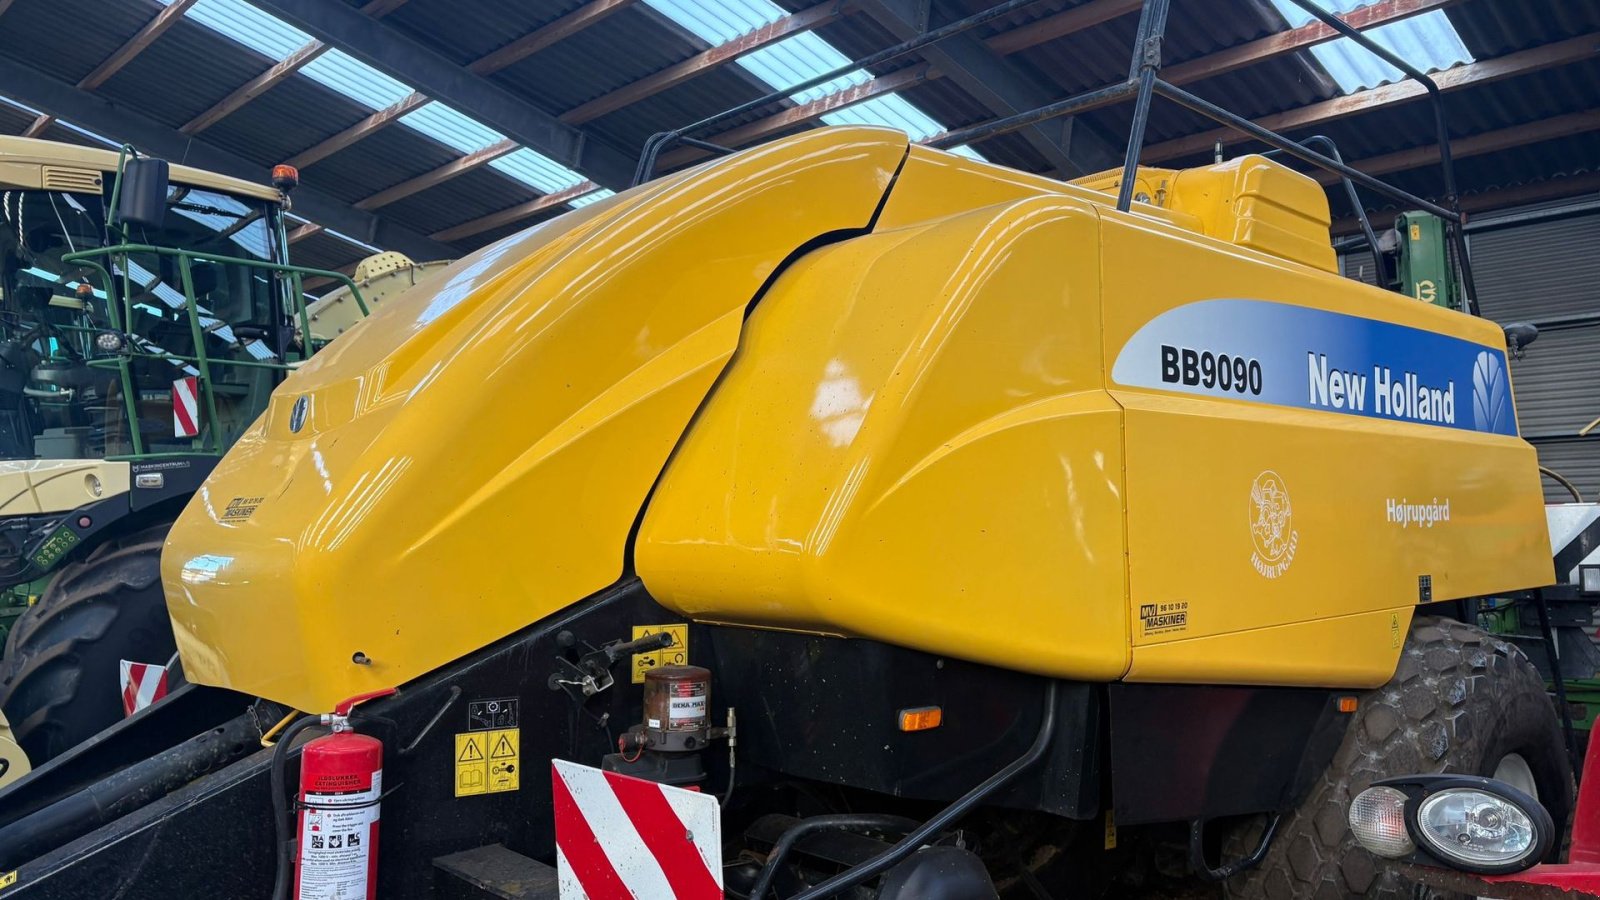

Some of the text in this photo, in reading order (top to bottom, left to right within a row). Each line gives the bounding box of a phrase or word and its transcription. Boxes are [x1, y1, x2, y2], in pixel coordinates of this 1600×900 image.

[1161, 345, 1262, 396] BB9090
[1308, 352, 1455, 424] New Holland
[225, 507, 256, 517] MASKINER
[1386, 497, 1450, 528] Højrupgård
[1250, 530, 1298, 579] HØJRUPGÅRD
[1147, 613, 1185, 627] MASKINER
[1168, 603, 1174, 611] 10
[1175, 602, 1180, 610] 19
